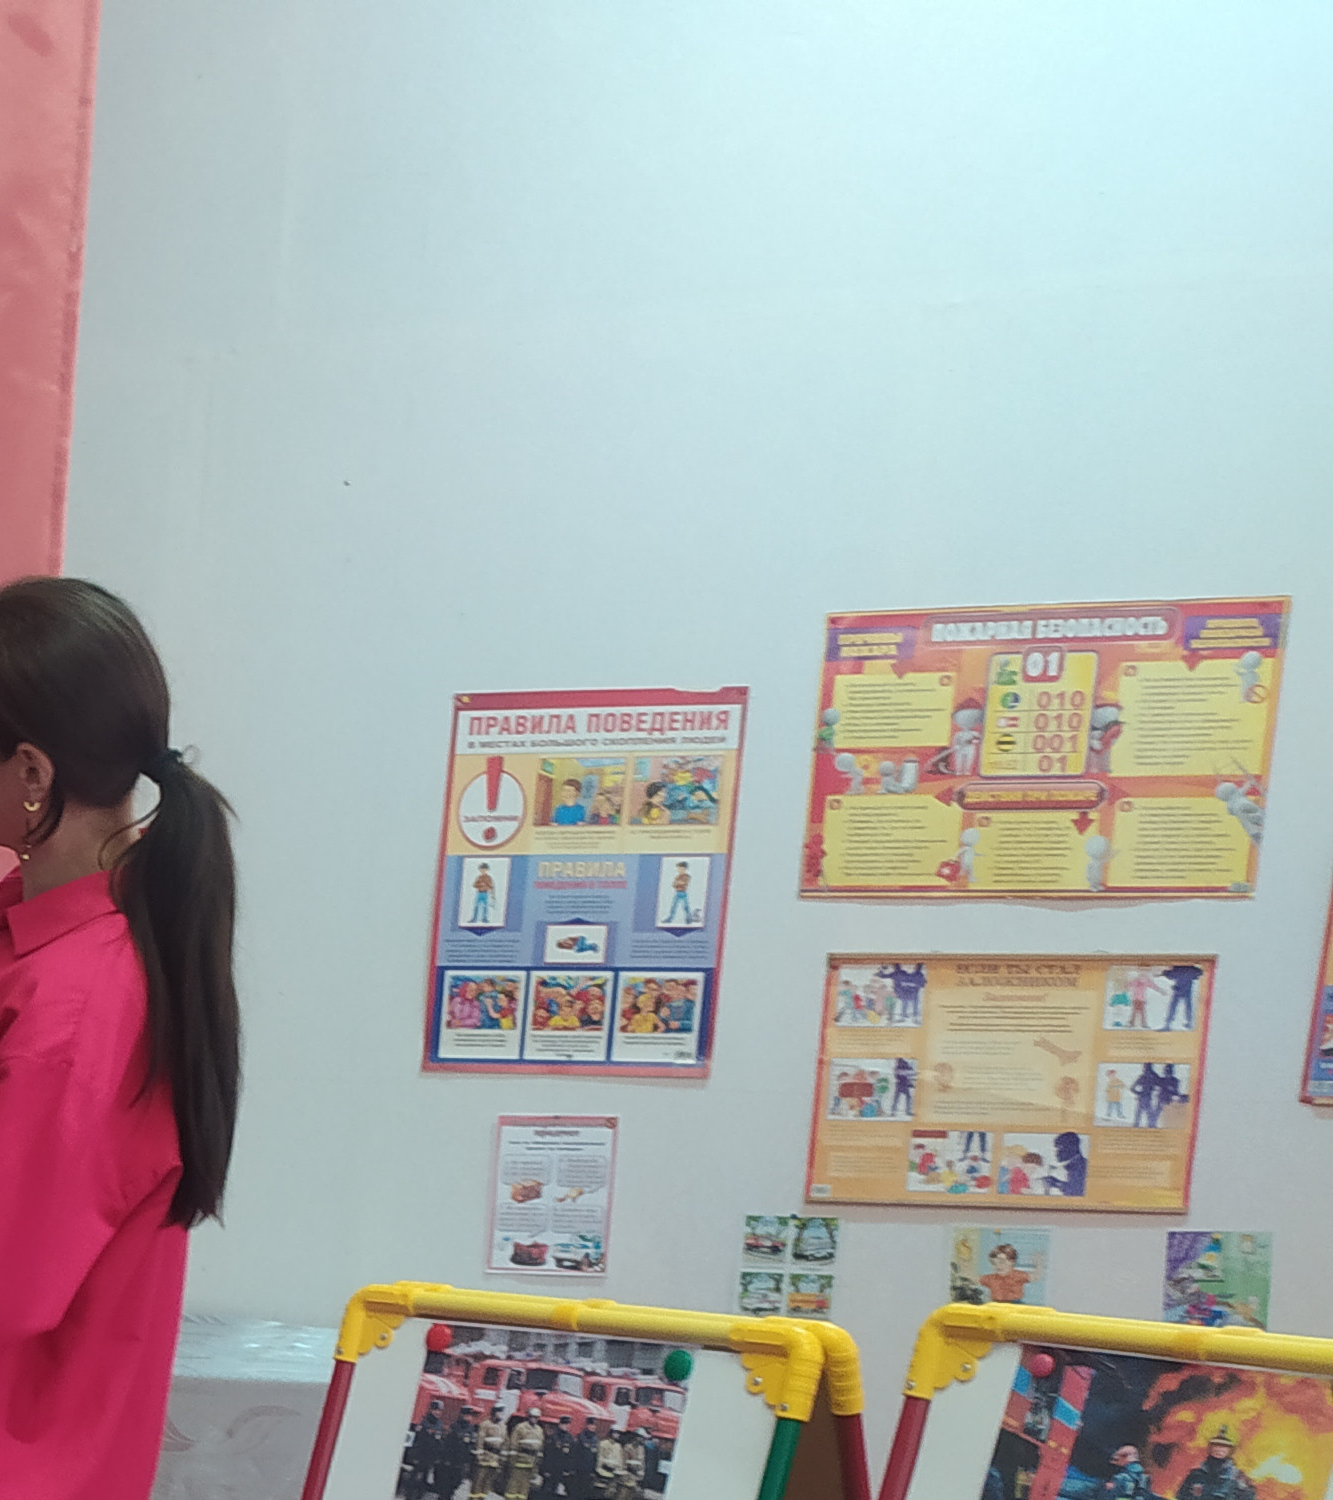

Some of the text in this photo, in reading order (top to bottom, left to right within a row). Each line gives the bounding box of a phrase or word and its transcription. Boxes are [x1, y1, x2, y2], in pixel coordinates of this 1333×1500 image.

[1025, 651, 1061, 677] 01
[1037, 690, 1086, 709] 010
[468, 710, 730, 736] ПРАВИЛА ПОВЕДЕНИЯ
[1034, 712, 1082, 731] 010
[1032, 734, 1078, 753] 001
[1037, 754, 1068, 773] 01
[537, 861, 626, 878] ПРАВИЛА
